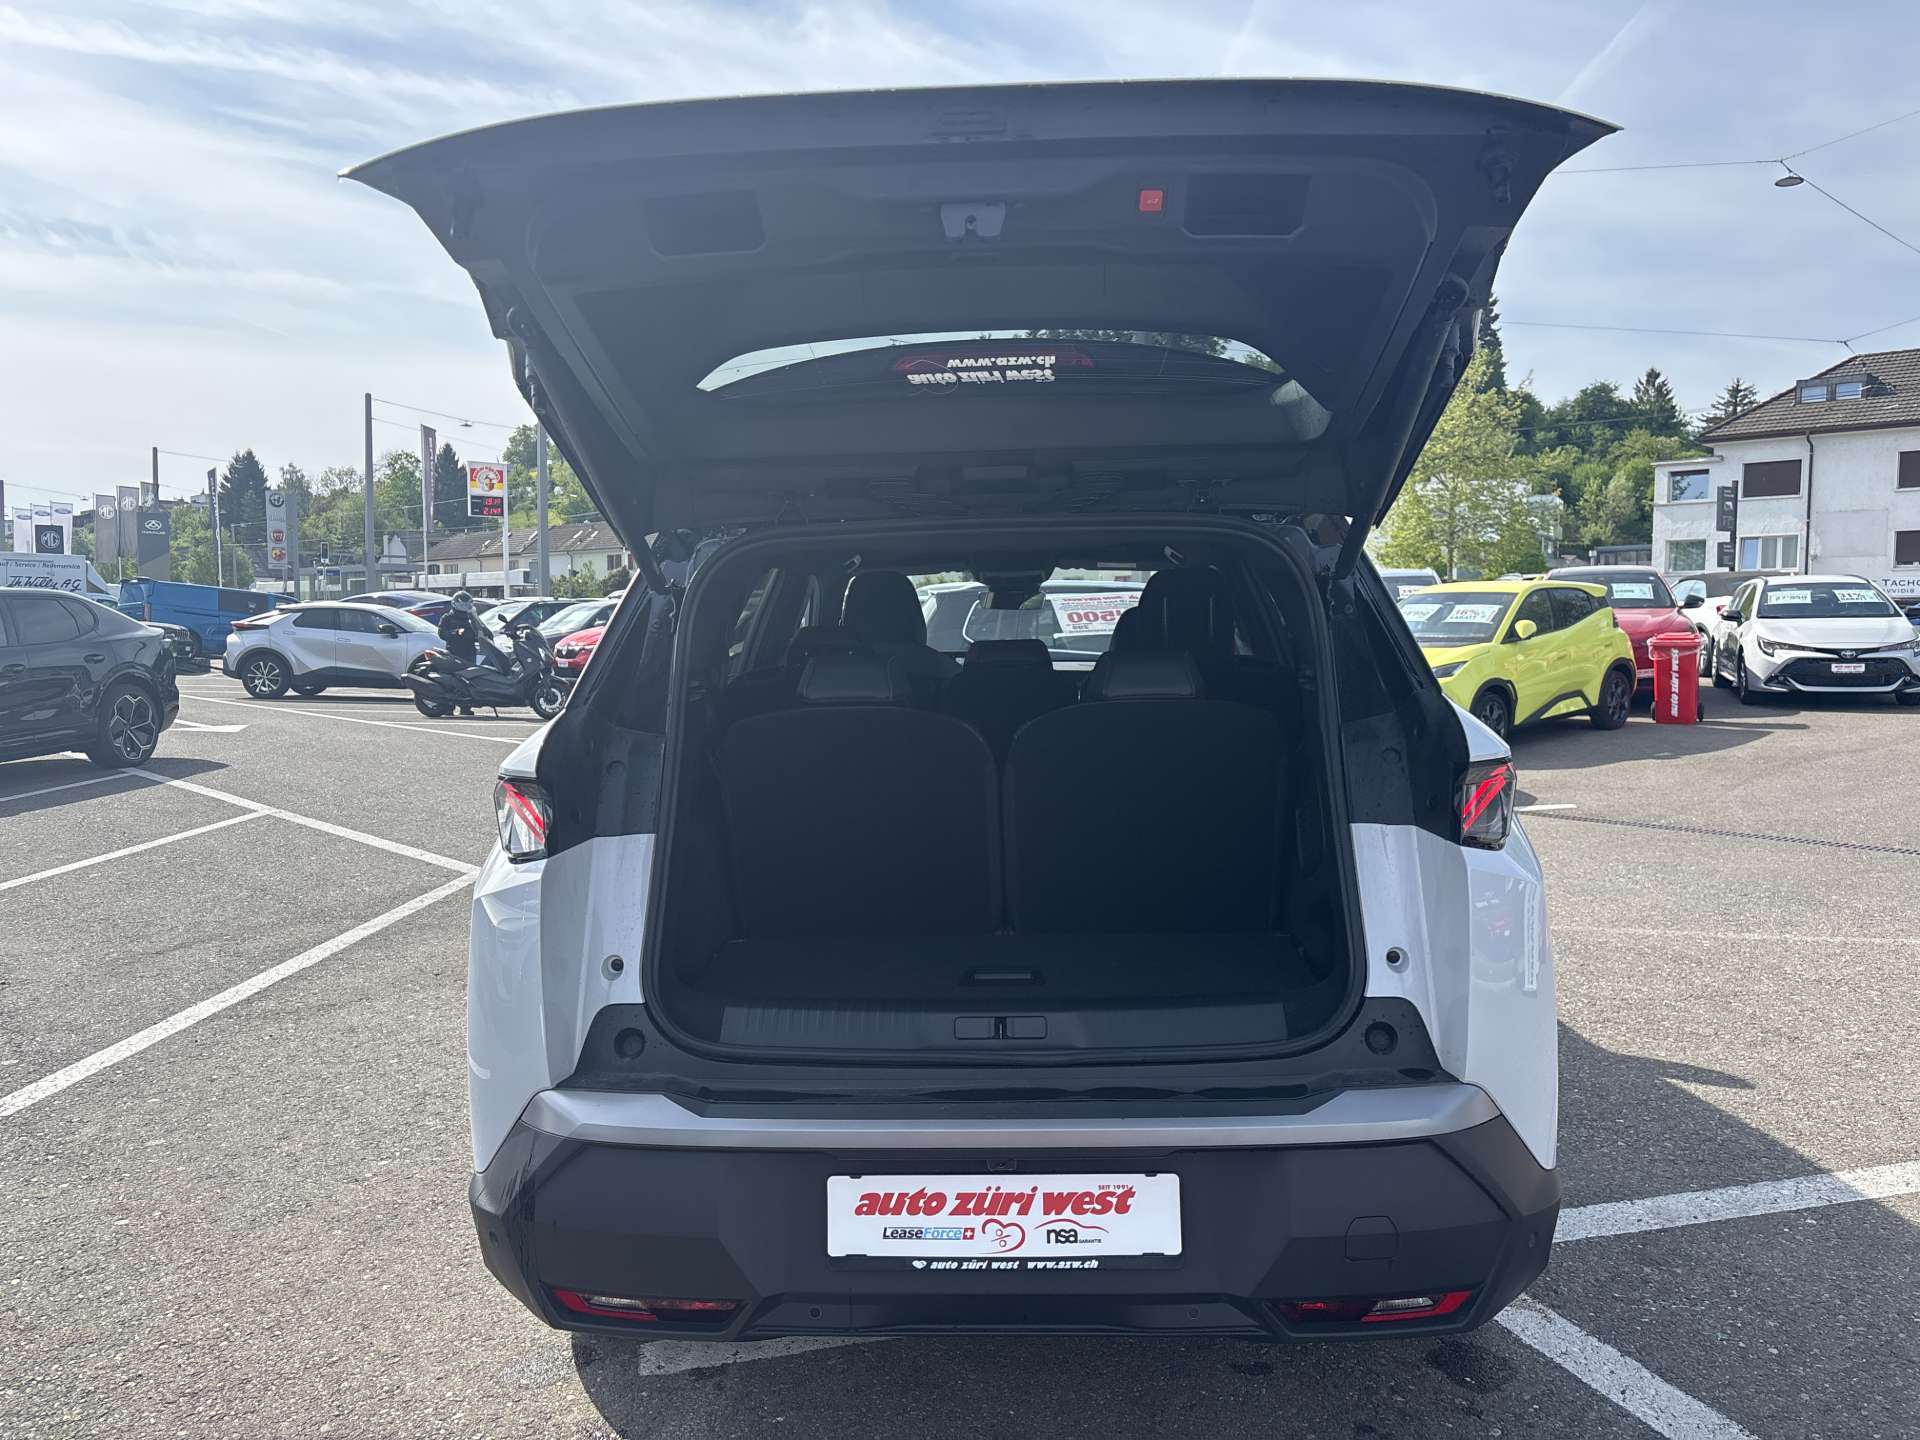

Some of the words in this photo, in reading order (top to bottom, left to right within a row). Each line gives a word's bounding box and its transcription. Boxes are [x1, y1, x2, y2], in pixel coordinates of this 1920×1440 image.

[60, 578, 82, 592] AG
[854, 1186, 948, 1216] auto
[948, 1186, 1039, 1216] züri
[1042, 1186, 1137, 1216] west
[882, 1226, 962, 1240] LeaseForce
[1046, 1228, 1079, 1244] nsa
[930, 1260, 958, 1270] auto
[961, 1259, 989, 1270] züri
[991, 1260, 1020, 1270] west
[1027, 1259, 1099, 1270] www.azw.ch
